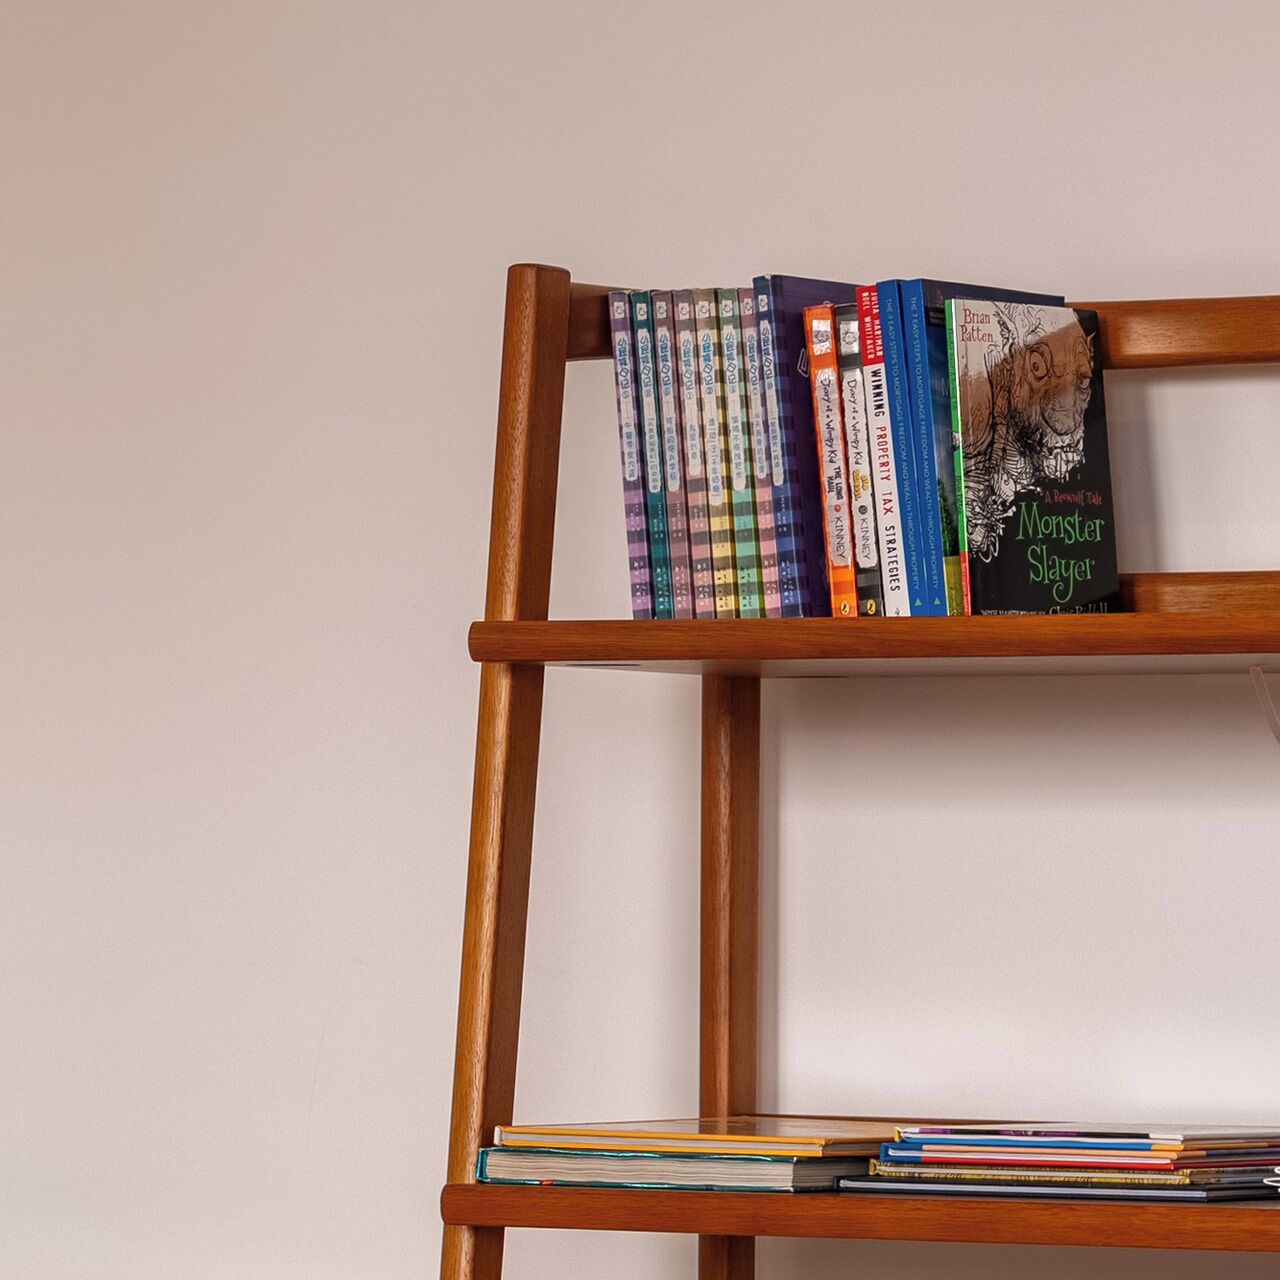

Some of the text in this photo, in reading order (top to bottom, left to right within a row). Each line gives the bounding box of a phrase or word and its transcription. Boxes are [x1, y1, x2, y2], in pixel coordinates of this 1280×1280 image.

[889, 319, 897, 340] EASY
[912, 320, 920, 340] EASY
[963, 308, 992, 325] Brian
[864, 316, 876, 359] WHITTAKER
[873, 320, 884, 357] HARTMAN
[959, 324, 994, 344] Patten
[891, 340, 899, 364] STEPS
[914, 340, 922, 363] STEPS
[892, 365, 900, 376] TO
[915, 364, 923, 375] TO
[847, 379, 858, 406] Diary
[893, 377, 904, 422] MORTGAGE
[917, 376, 927, 421] MORTGAGE
[824, 420, 837, 452] Wimpy
[850, 421, 861, 453] Wimpy
[897, 423, 908, 459] FREEDOM
[920, 422, 930, 458] FREEDOM
[827, 449, 839, 465] Kid
[833, 466, 842, 480] THE
[853, 451, 863, 467] Kid
[901, 462, 910, 479] AND
[923, 461, 931, 477] AND
[870, 368, 901, 593] WINNING PROPERTY TAX STRATEGIES
[903, 480, 912, 511] WEALTH
[925, 478, 934, 511] WEALTH
[1044, 490, 1103, 507] A Beowulf Tale
[833, 516, 846, 559] KINNEY
[860, 518, 871, 560] KINNEY
[906, 512, 916, 551] THROUGH
[928, 512, 937, 550] THROUGH
[1015, 502, 1105, 545] Monster
[910, 552, 921, 591] PROPERTY
[930, 551, 939, 589] PROPERTY
[1027, 543, 1096, 604] Slayer
